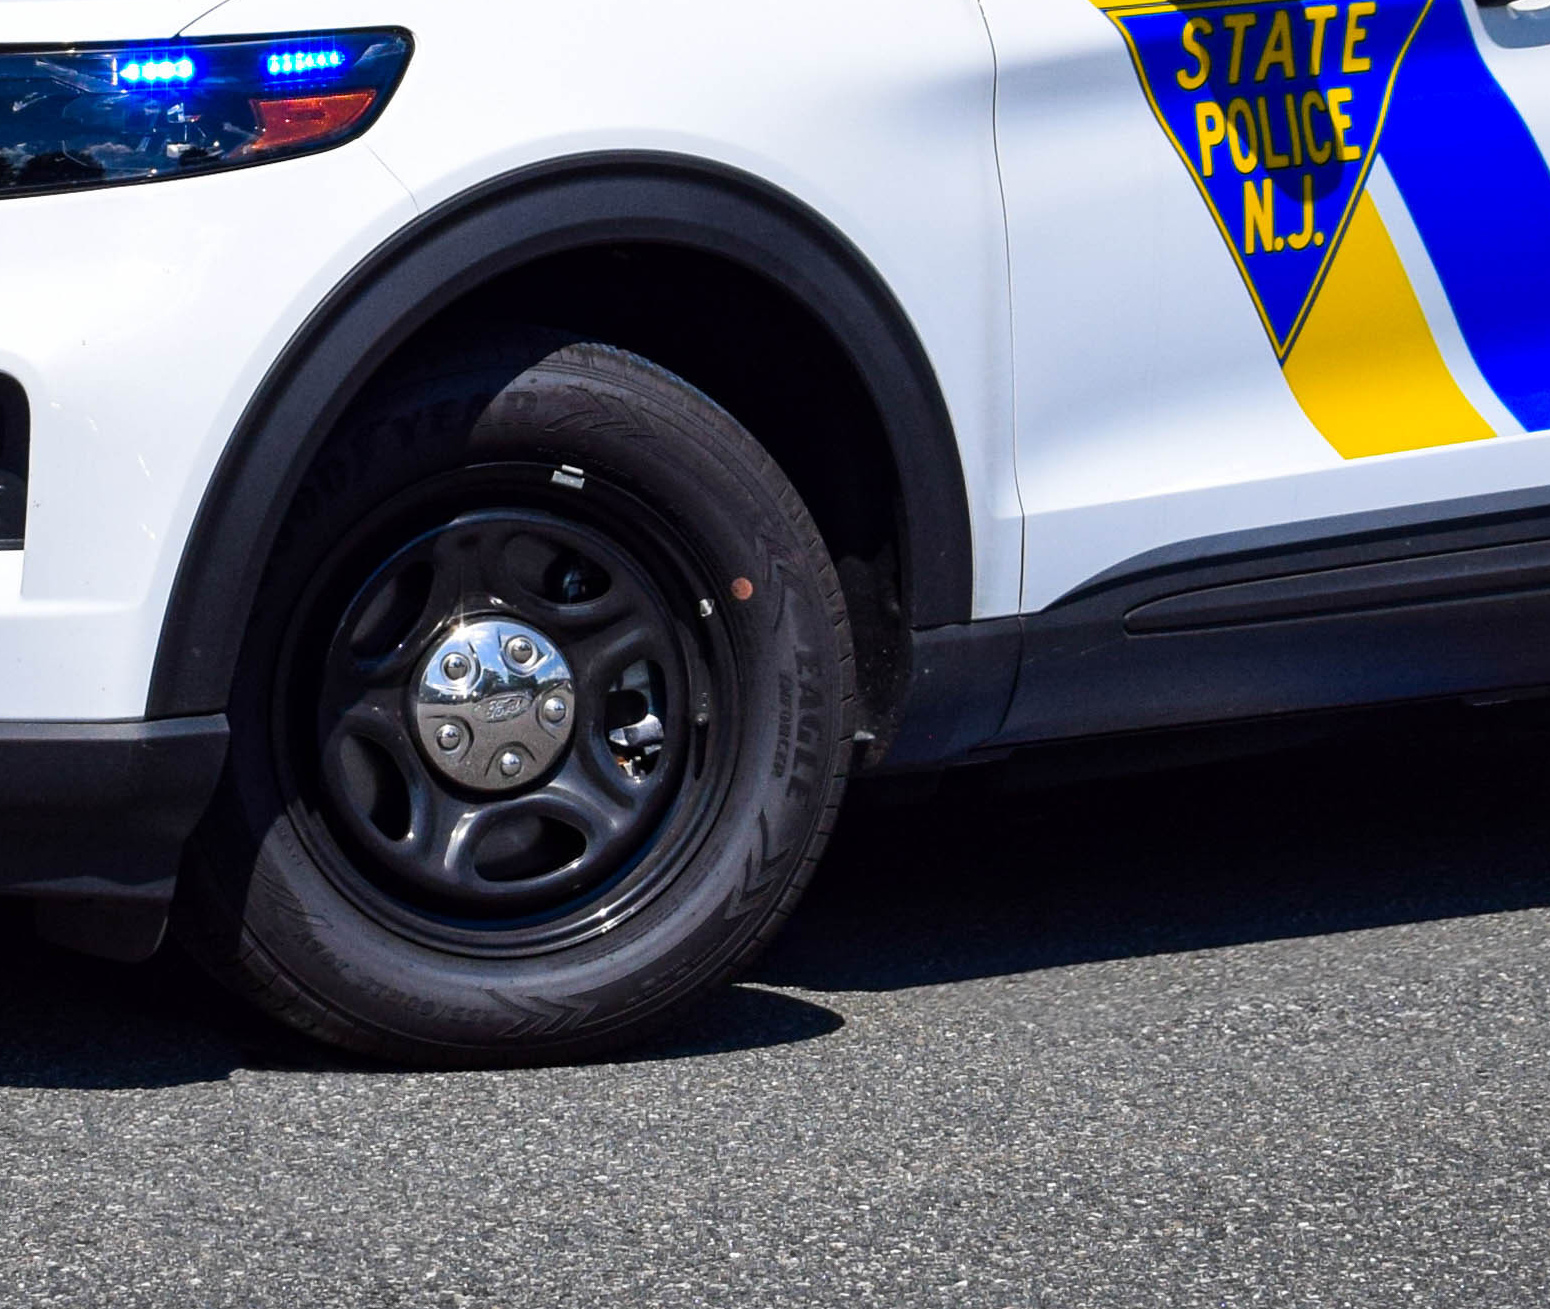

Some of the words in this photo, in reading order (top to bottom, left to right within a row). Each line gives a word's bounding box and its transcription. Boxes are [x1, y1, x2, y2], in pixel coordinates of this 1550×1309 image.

[1176, 1, 1377, 90] STATE
[1194, 87, 1361, 177] POLICE
[1243, 174, 1324, 254] N.J.
